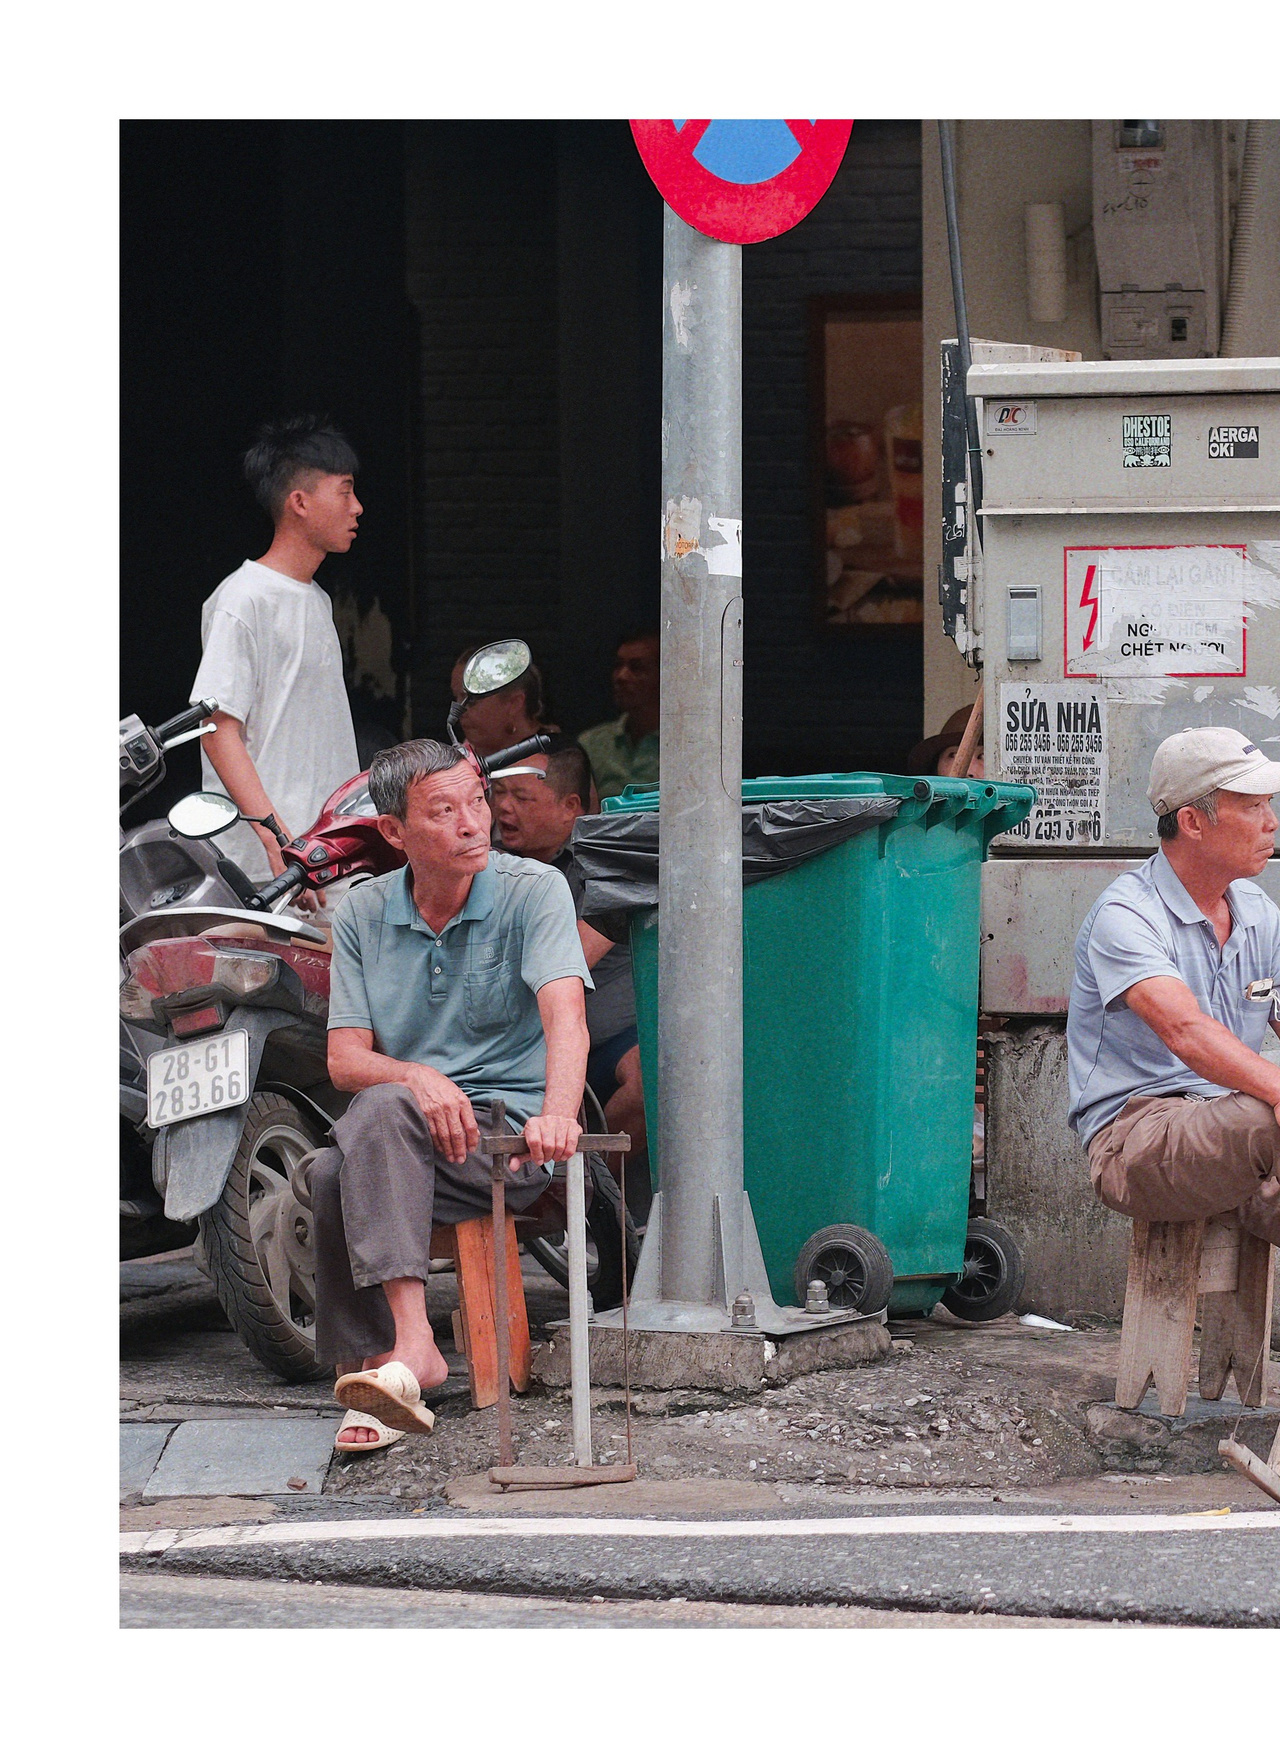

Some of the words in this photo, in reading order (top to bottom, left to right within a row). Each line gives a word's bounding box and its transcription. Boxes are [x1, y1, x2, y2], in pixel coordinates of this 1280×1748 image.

[1123, 416, 1170, 438] DHESTOE
[1209, 427, 1258, 443] AERGA
[1006, 688, 1050, 732] SỬA
[1057, 695, 1102, 733] NHÀ
[1005, 733, 1018, 751] 056
[1019, 733, 1032, 752] 255
[1033, 733, 1051, 752] 3456
[1057, 734, 1070, 752] 056
[1071, 734, 1083, 752] 255
[1085, 734, 1102, 753] 3456
[163, 1039, 230, 1086] 28-G1
[153, 1070, 241, 1122] 283.66
